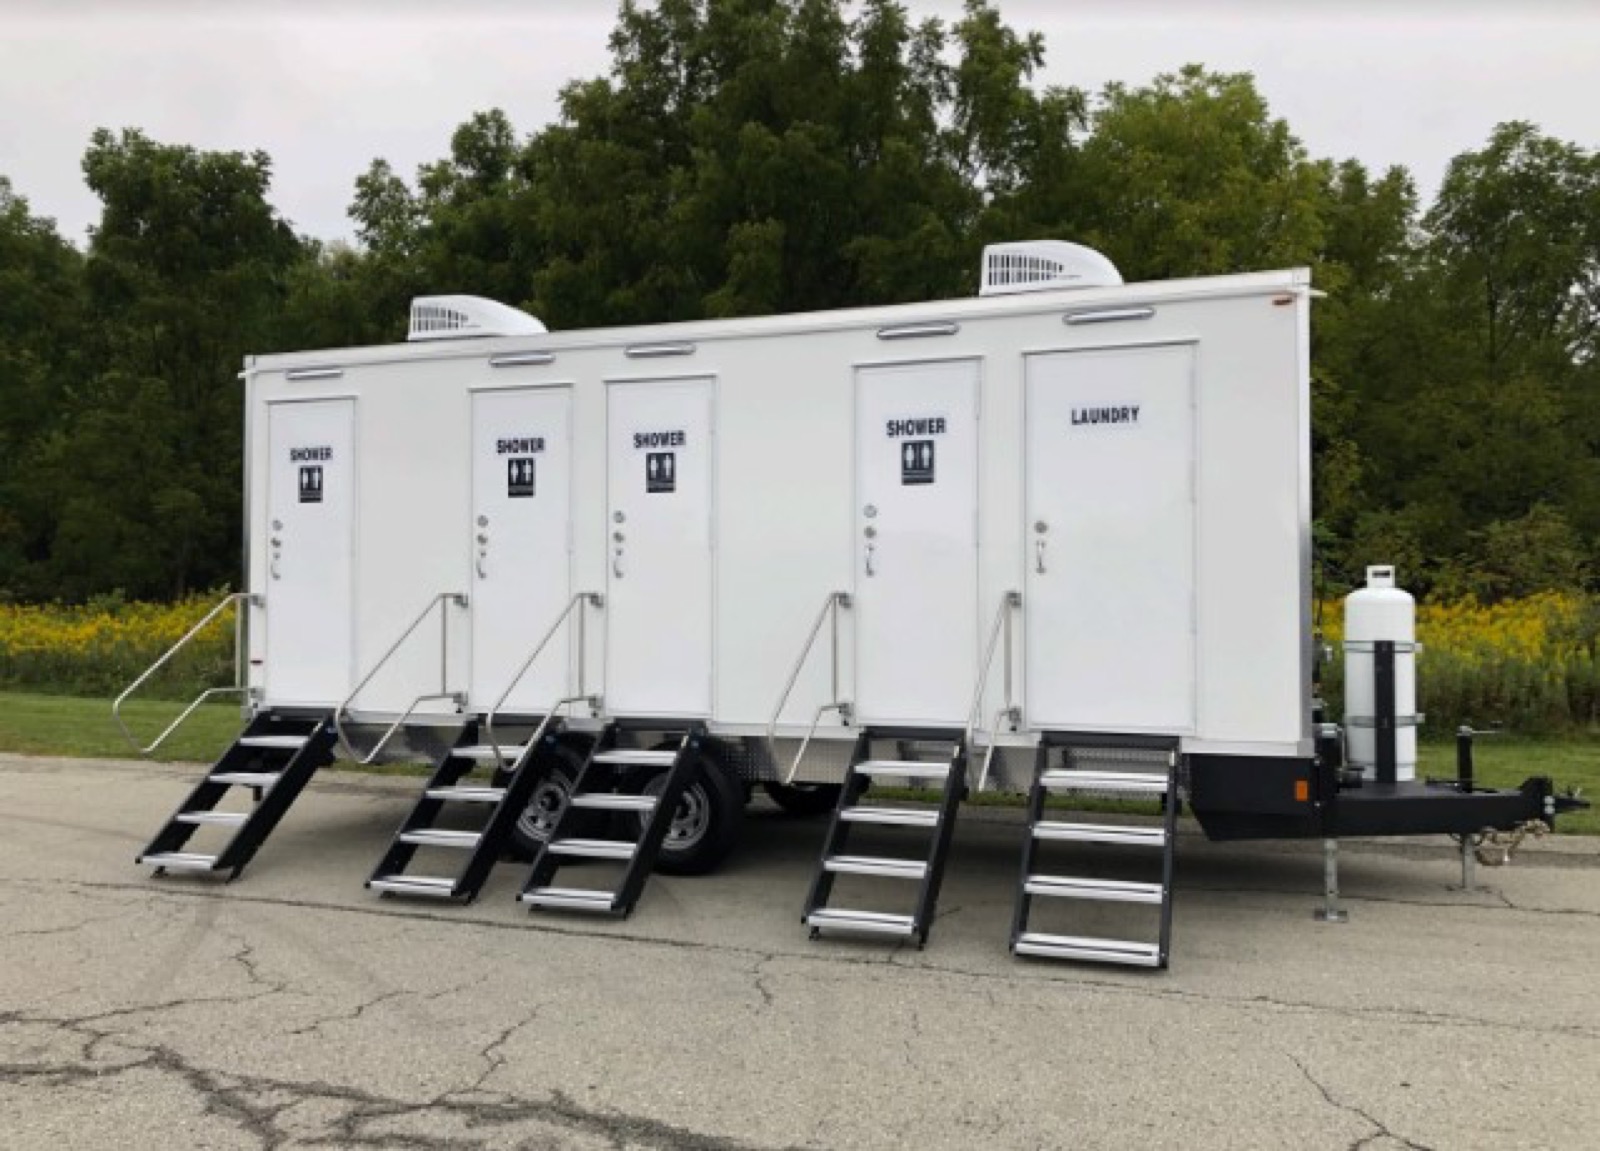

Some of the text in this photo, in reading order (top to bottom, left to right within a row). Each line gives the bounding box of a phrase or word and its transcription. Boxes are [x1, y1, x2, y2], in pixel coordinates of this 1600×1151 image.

[1071, 406, 1140, 426] LAUNDRY
[886, 417, 946, 438] SHOWER
[496, 437, 545, 455] SHOWER
[633, 429, 685, 448] SHOWER
[289, 446, 333, 462] SHOWER
